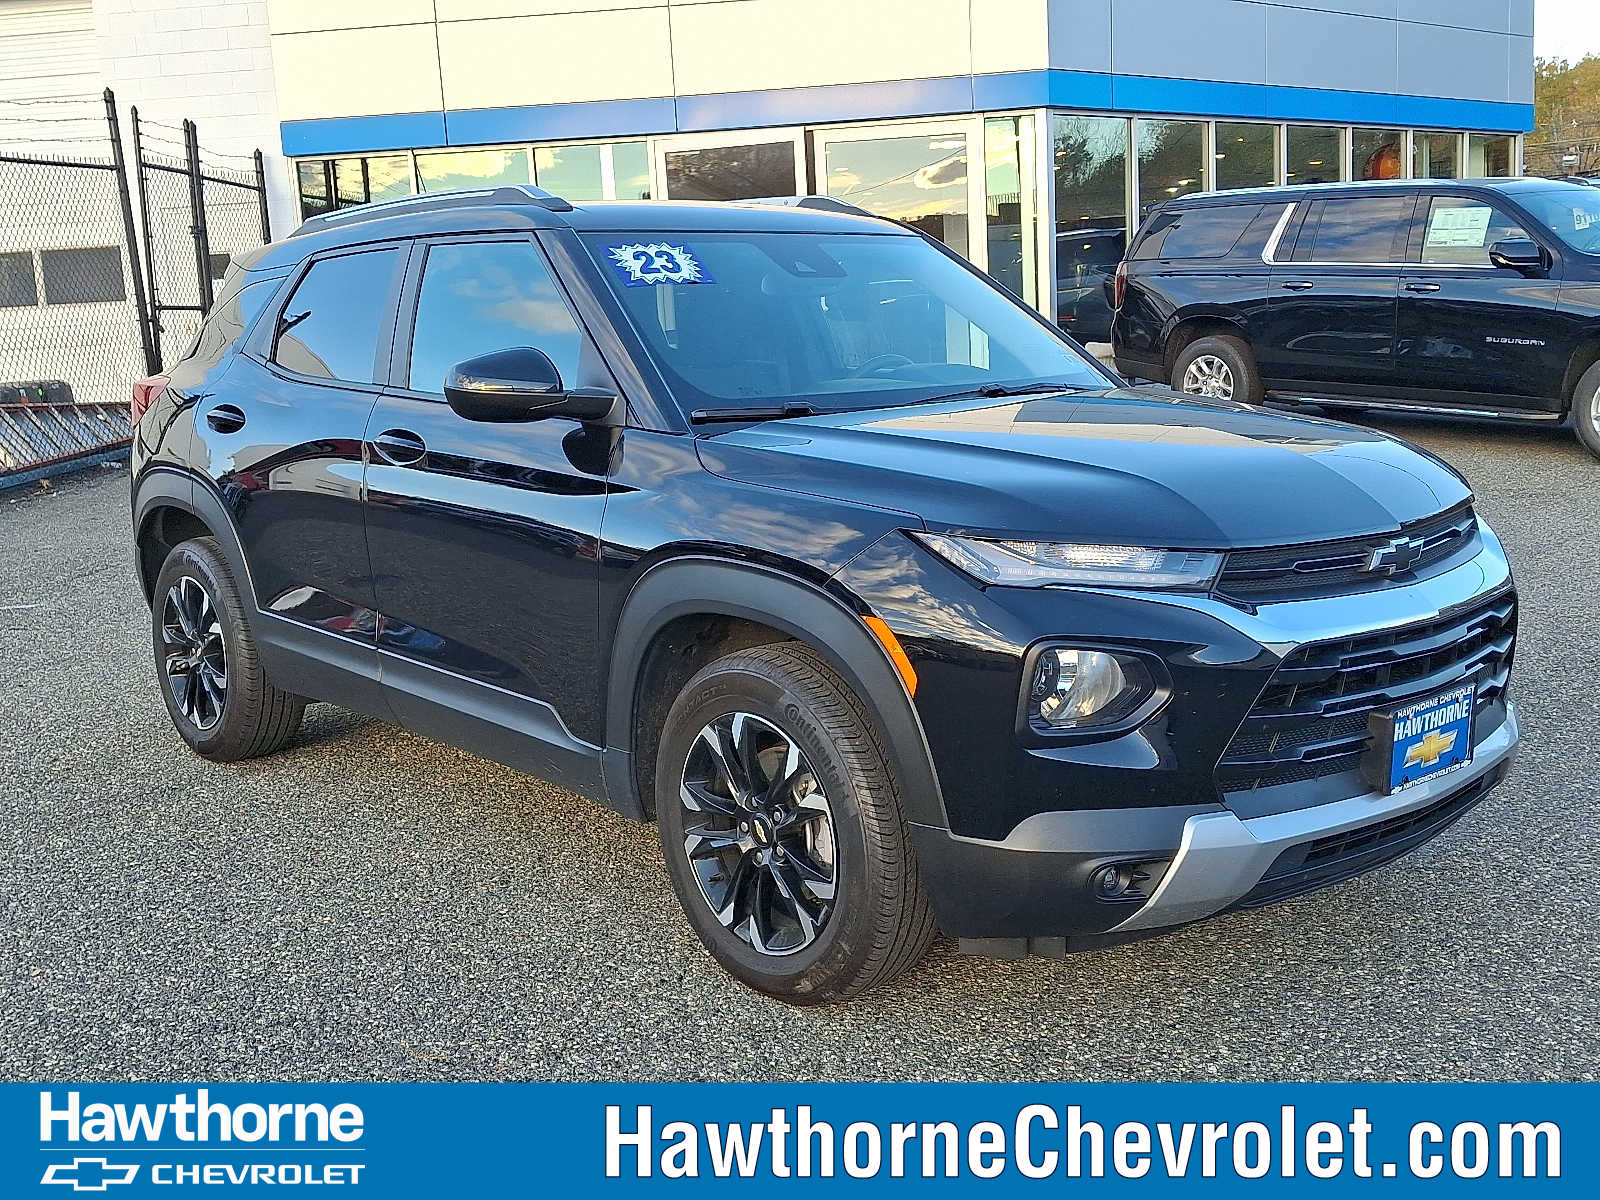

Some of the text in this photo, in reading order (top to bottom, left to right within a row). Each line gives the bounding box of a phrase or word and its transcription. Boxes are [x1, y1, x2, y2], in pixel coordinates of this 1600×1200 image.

[632, 250, 683, 275] 23
[1485, 336, 1546, 346] SUBURBAN
[1397, 685, 1476, 719] HAWTHORNE CHEVROLET
[1394, 699, 1470, 742] HAWTHORNE
[784, 703, 845, 785] Continental
